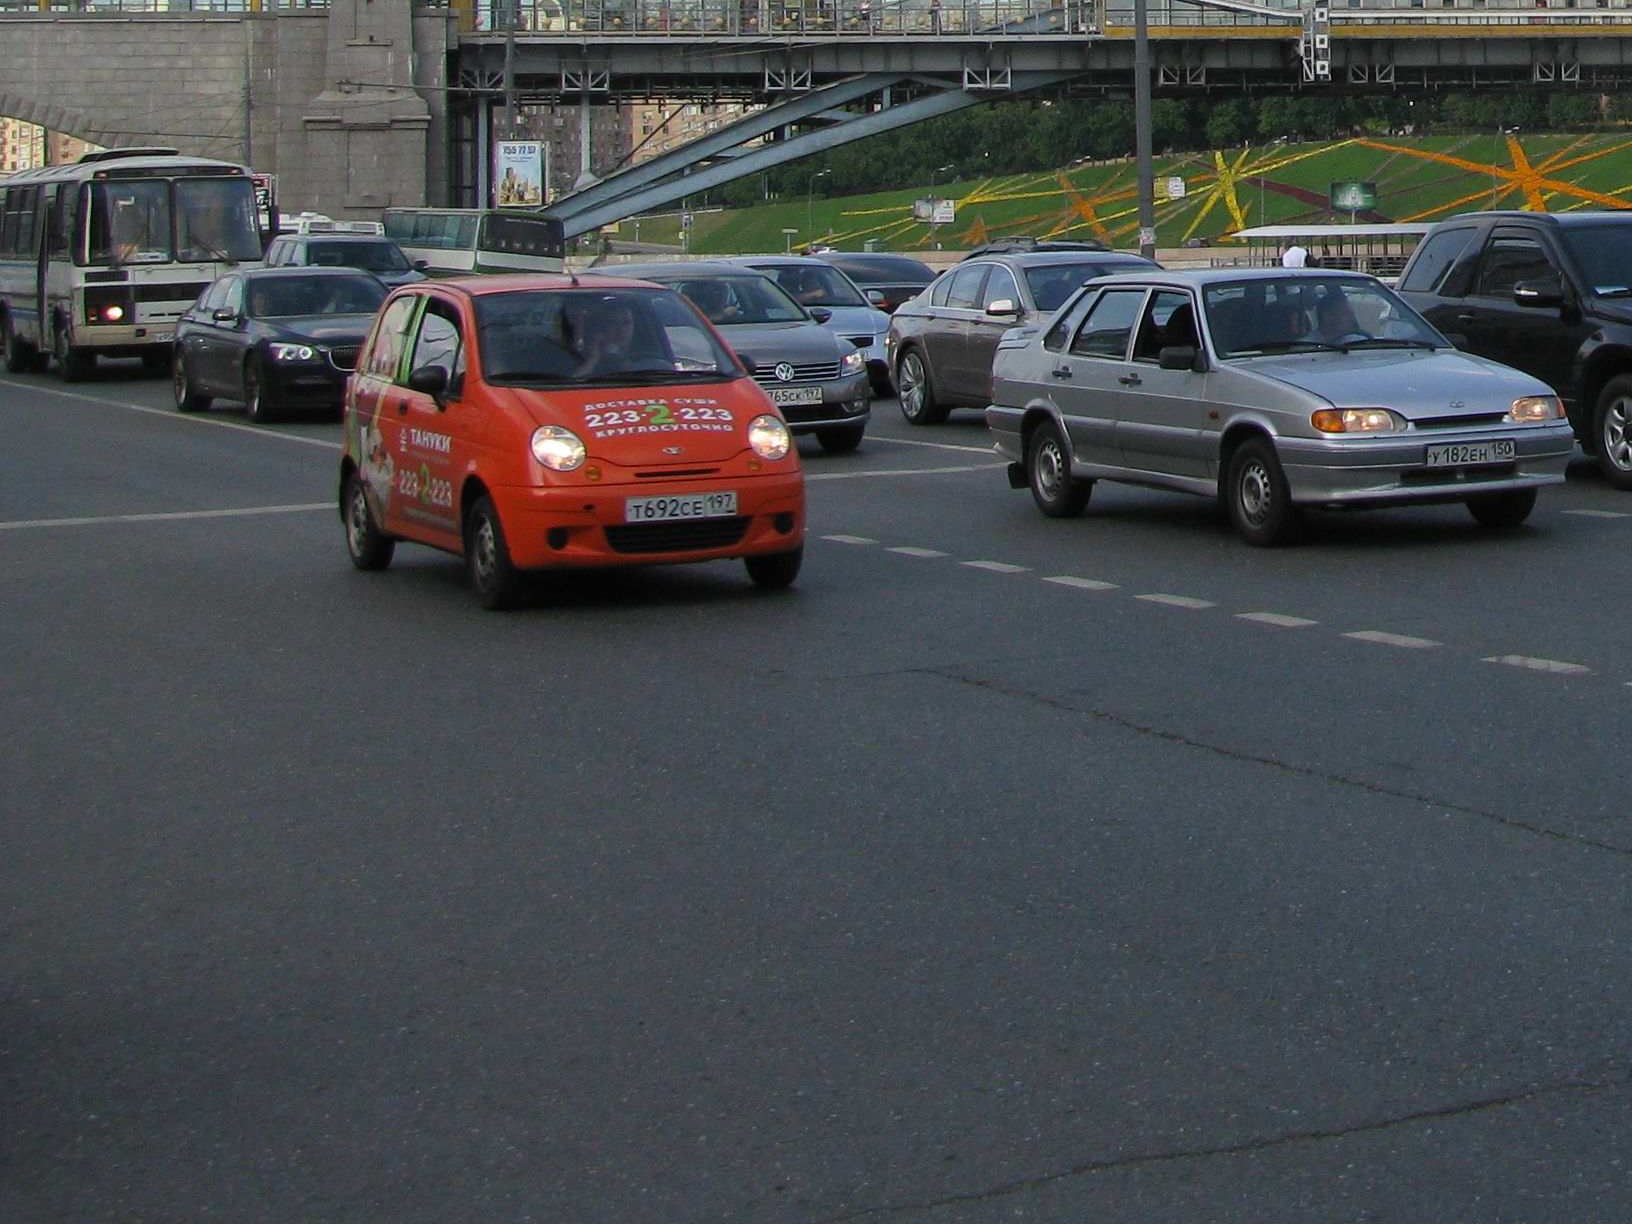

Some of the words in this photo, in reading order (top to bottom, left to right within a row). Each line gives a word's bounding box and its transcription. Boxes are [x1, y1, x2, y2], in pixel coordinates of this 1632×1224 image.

[584, 398, 669, 411] ДОСТАВКА
[584, 405, 733, 427] 223-2-223
[410, 428, 452, 453] ТАНУКИ
[595, 424, 734, 438] КРУГЛОСУТОЧНО
[399, 463, 453, 508] 223-2-223
[707, 493, 732, 509] 197
